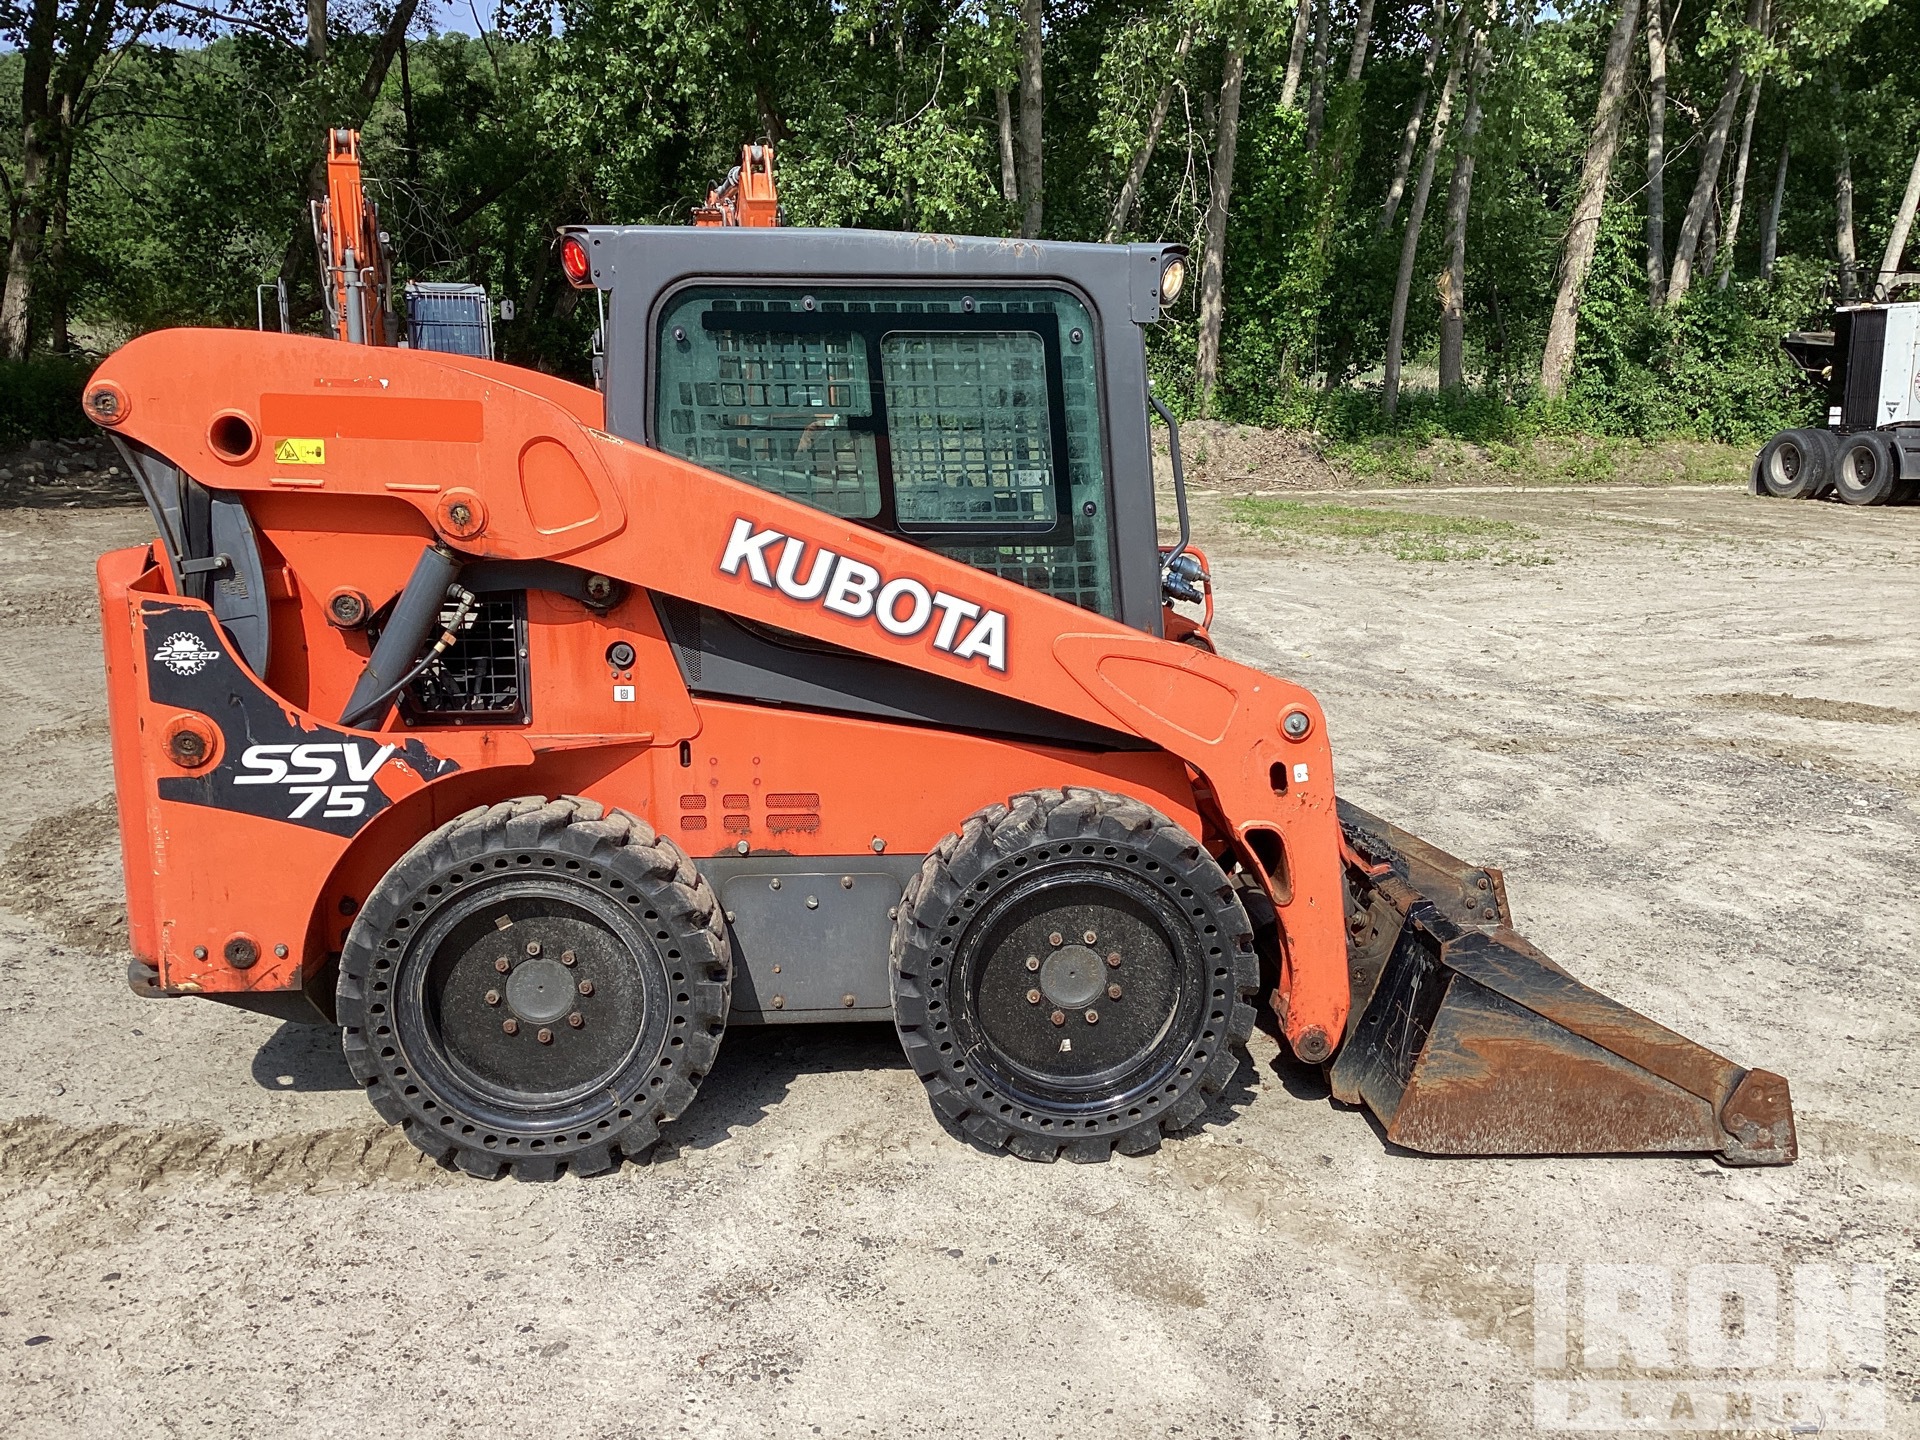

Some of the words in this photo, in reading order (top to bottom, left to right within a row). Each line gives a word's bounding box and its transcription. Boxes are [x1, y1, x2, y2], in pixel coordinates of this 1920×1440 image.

[719, 517, 1006, 672] KUBOTA
[233, 743, 396, 785] SSV
[287, 785, 368, 819] 75
